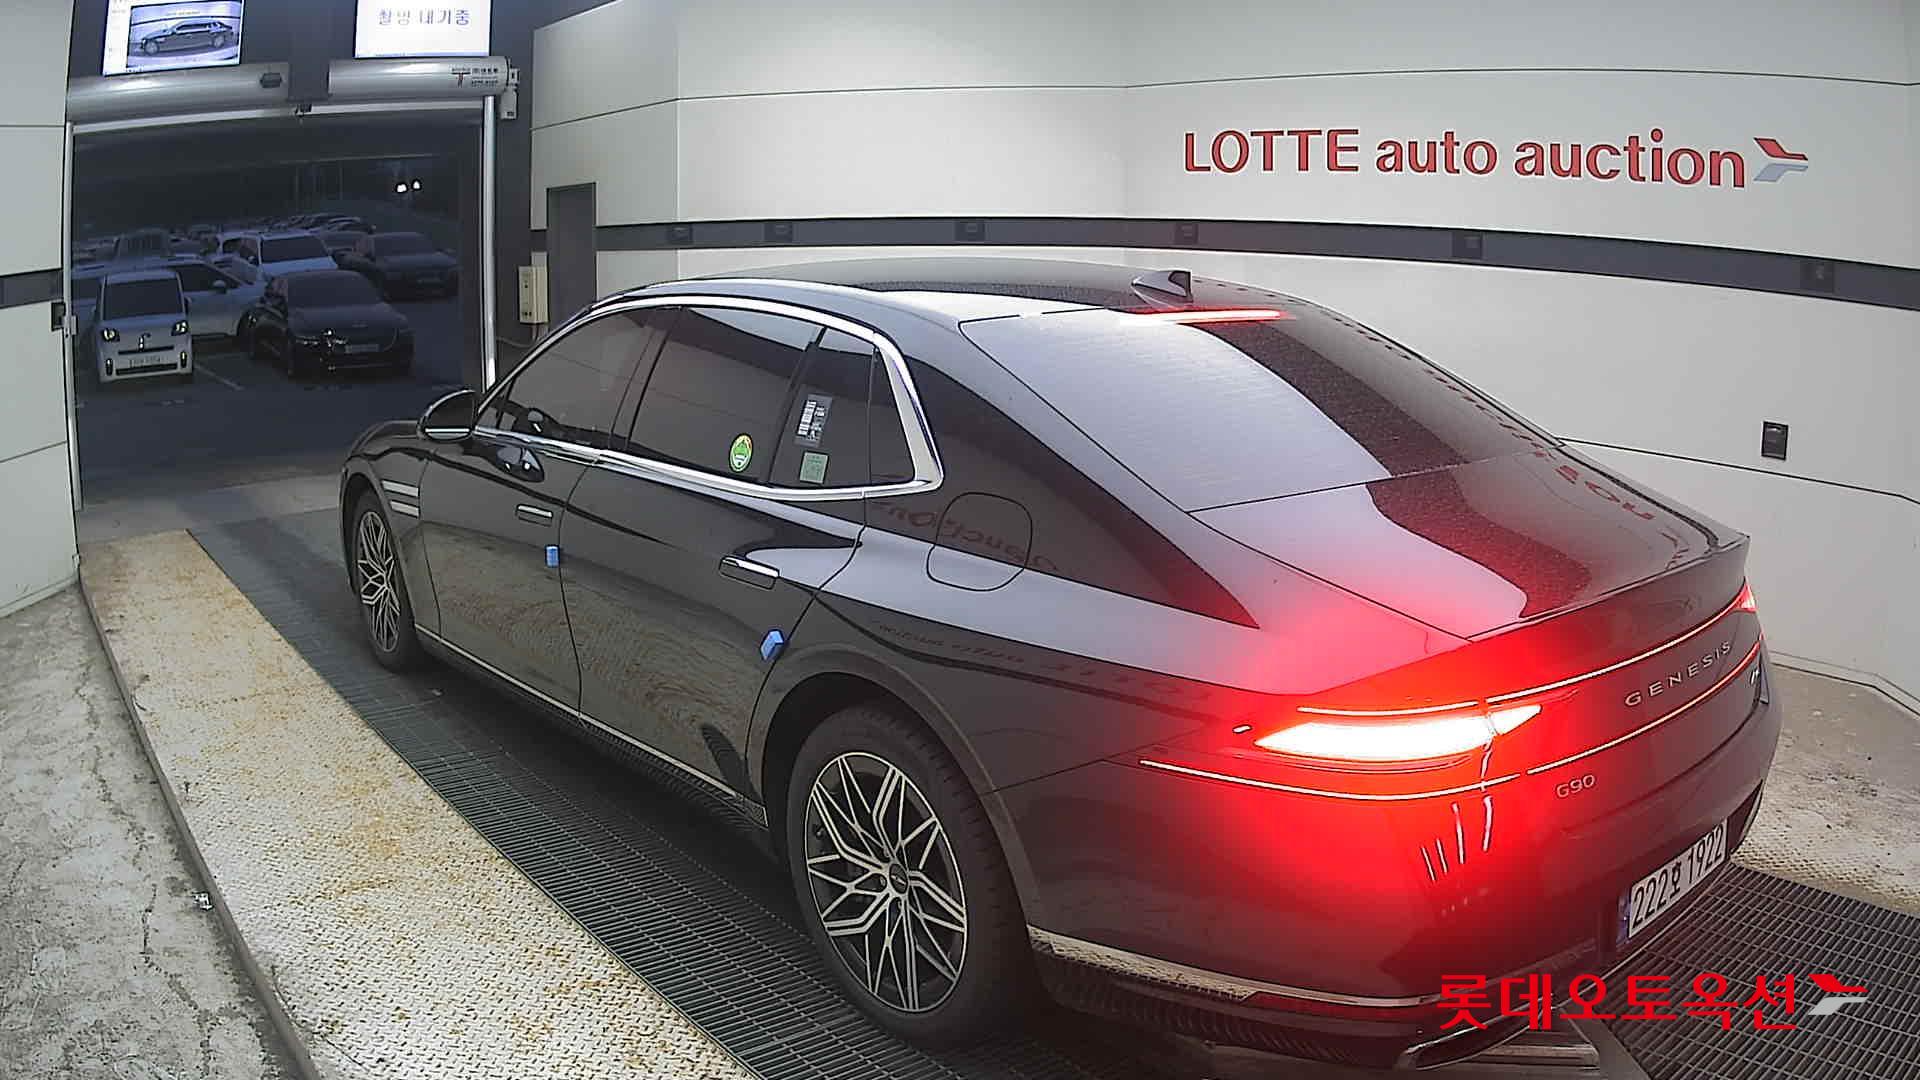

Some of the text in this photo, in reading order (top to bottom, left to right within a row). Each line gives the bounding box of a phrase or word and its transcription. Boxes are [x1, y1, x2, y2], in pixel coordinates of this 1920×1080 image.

[1184, 128, 1744, 188] LOTTE auto auction
[1624, 640, 1732, 706] GENESIS
[1556, 774, 1596, 798] G90
[1687, 823, 1723, 884] 1922
